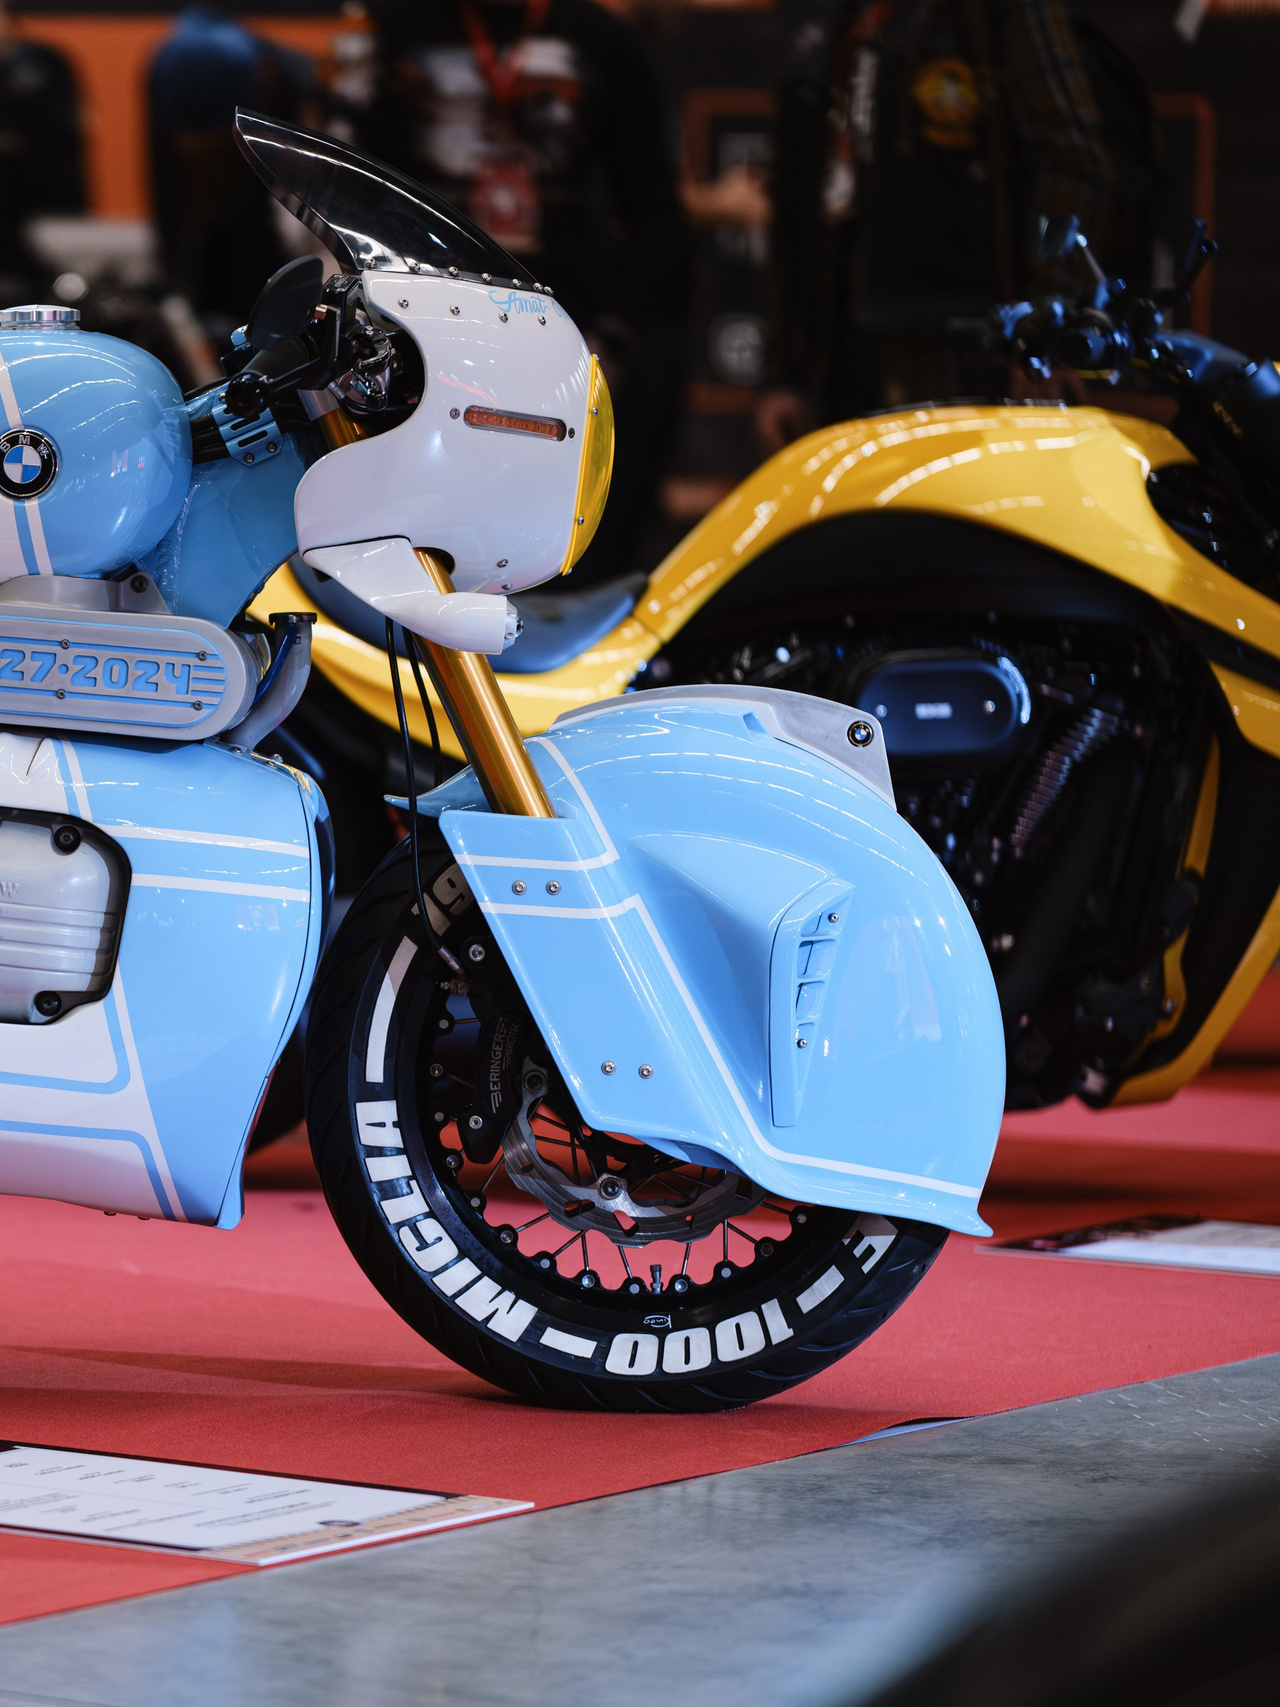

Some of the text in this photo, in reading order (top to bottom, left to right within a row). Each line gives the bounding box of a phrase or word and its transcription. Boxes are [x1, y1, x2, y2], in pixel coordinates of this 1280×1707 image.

[0, 434, 49, 459] BMW
[489, 1016, 507, 1114] BERINGER
[355, 1099, 539, 1342] MIGLIA
[605, 1298, 794, 1376] 1000
